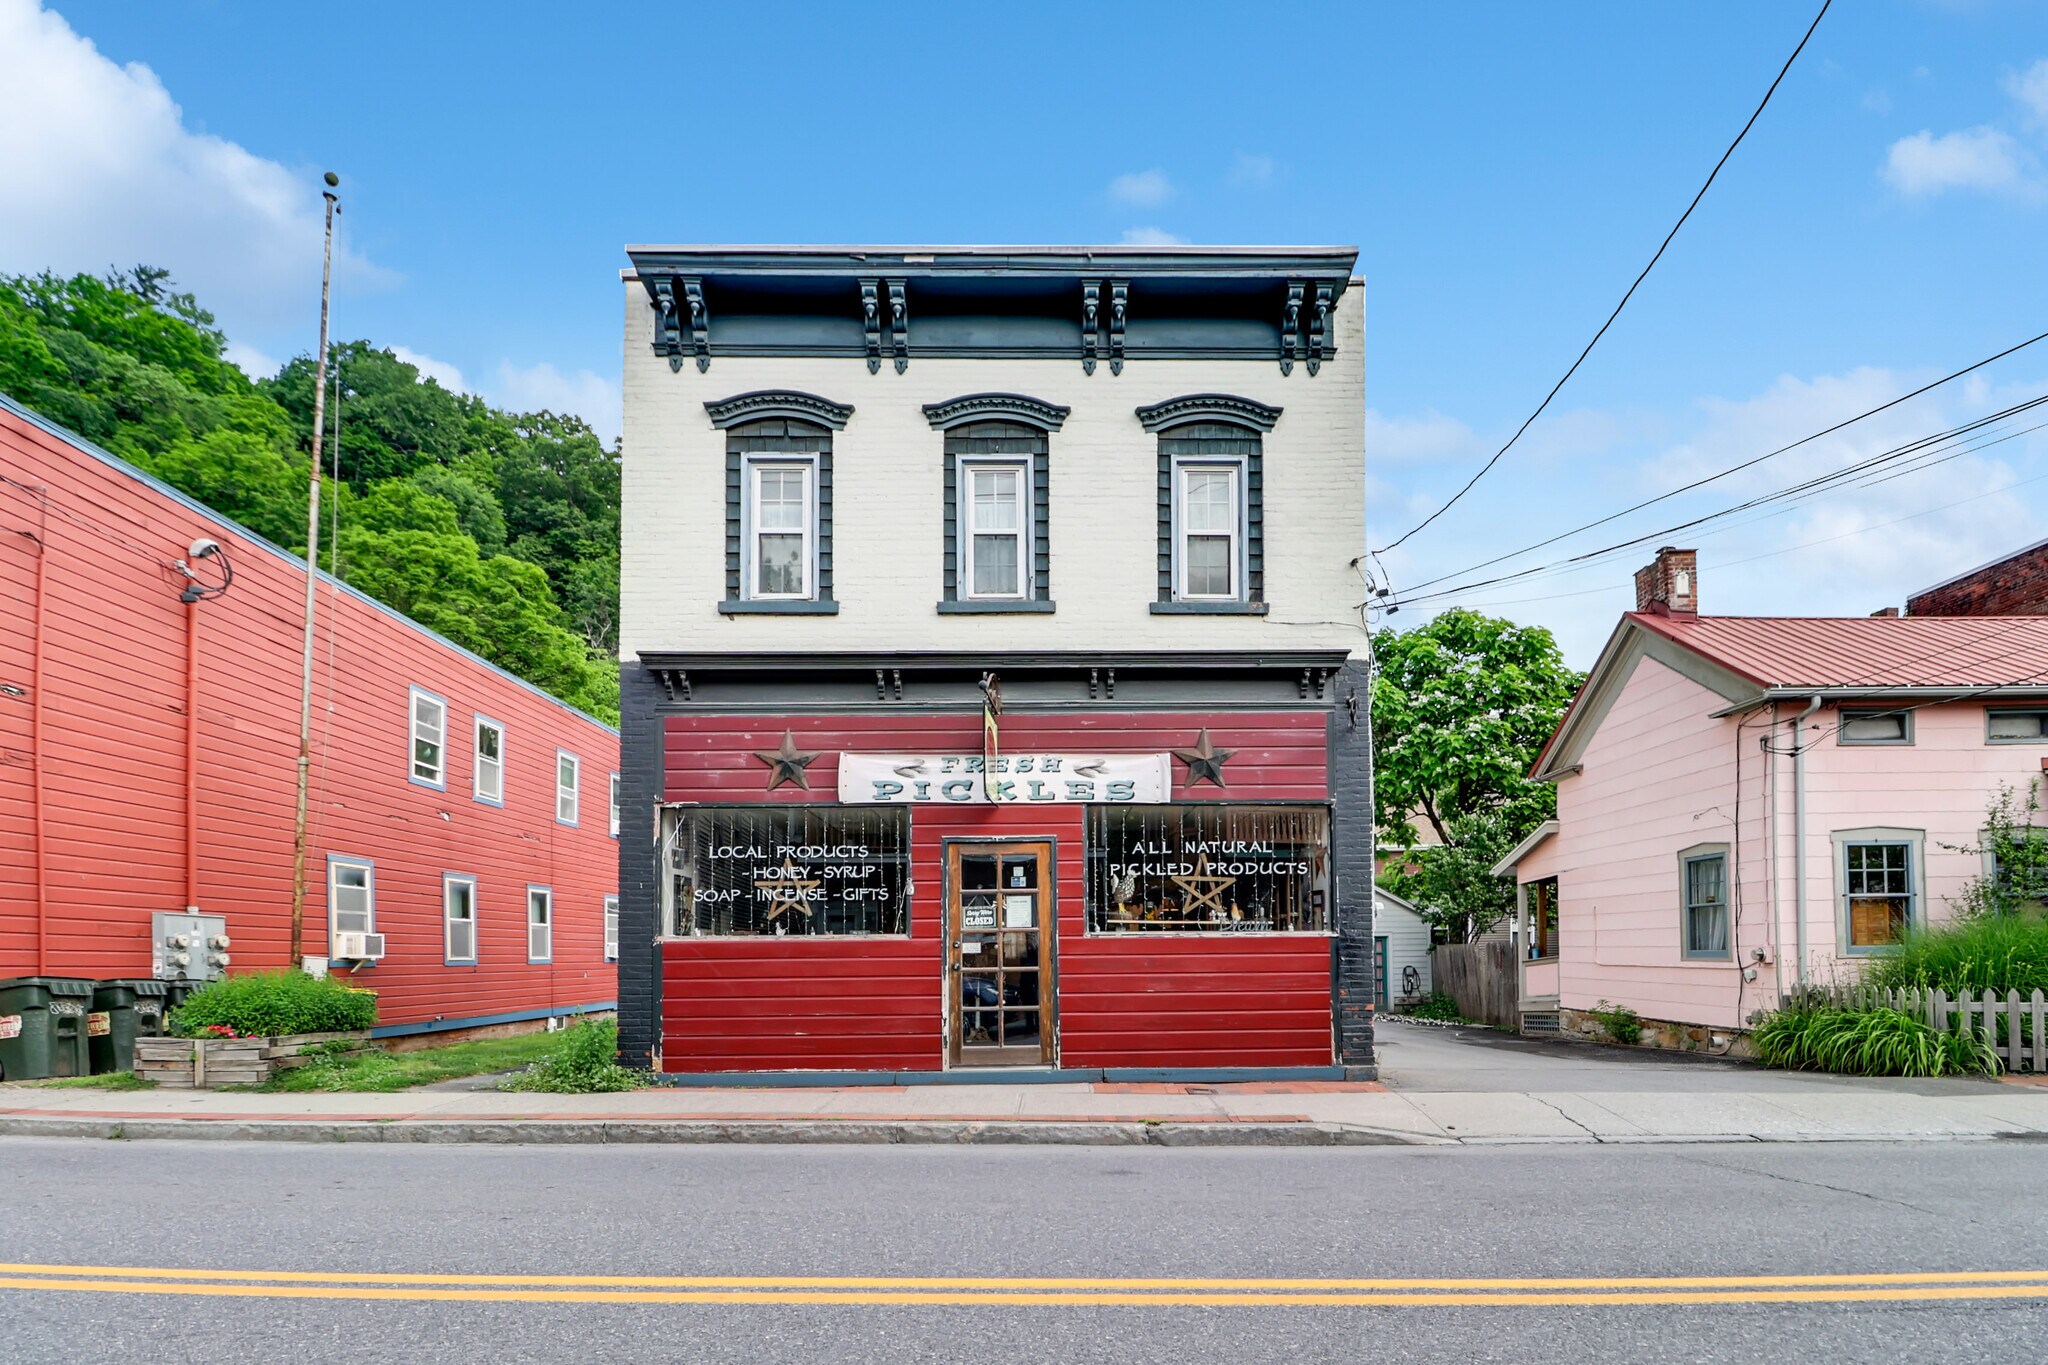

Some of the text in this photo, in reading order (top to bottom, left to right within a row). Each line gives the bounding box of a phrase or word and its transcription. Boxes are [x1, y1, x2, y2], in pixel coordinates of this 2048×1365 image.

[941, 756, 1063, 773] FRESH
[872, 780, 1136, 801] PICKLES
[709, 845, 869, 858] LOCAL PRODUCTS
[1132, 840, 1272, 854] ALL NATURAL
[754, 866, 811, 879] HONEY
[1110, 862, 1308, 876] PICKLED PRODUCTS
[694, 889, 741, 902] SOAP
[757, 888, 828, 902] INCENSE
[965, 917, 993, 926] CLOSED
